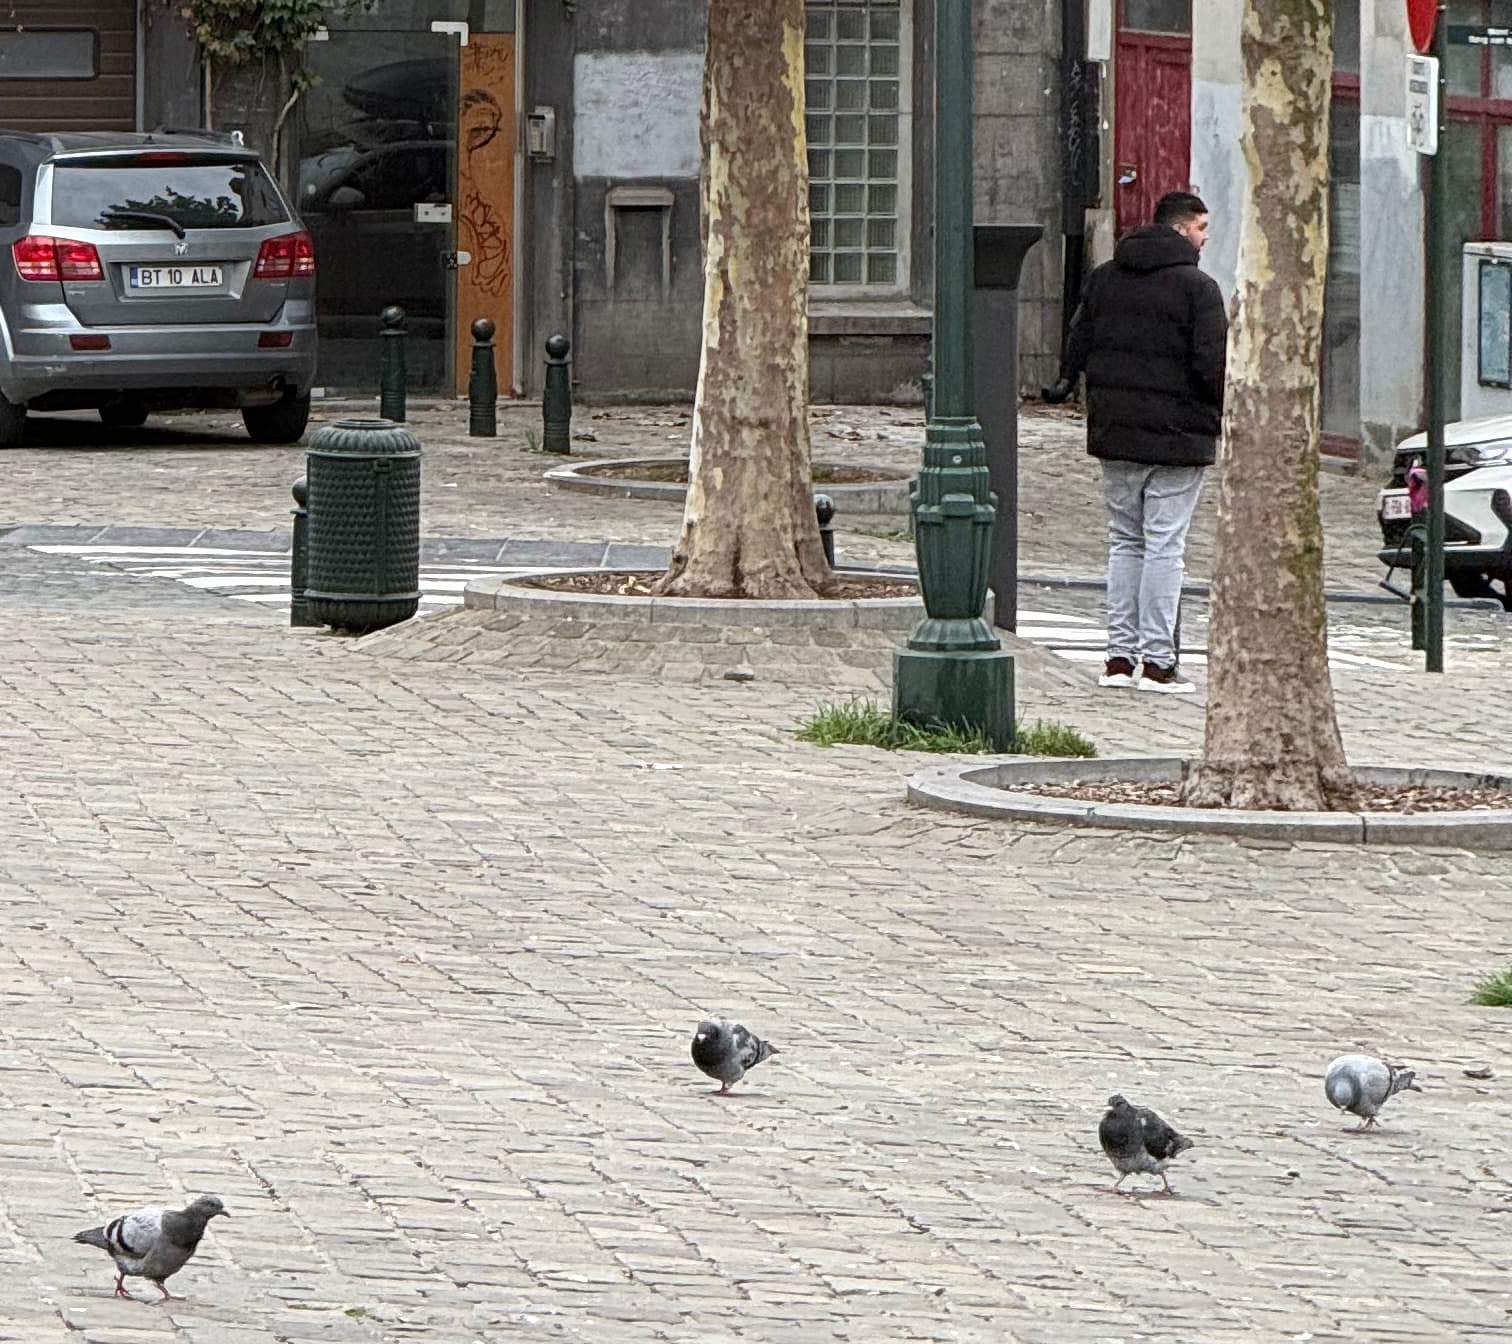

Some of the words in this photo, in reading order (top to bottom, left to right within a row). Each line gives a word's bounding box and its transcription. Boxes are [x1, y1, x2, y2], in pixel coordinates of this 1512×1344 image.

[141, 269, 162, 285] BT
[167, 269, 183, 285] 10
[191, 269, 219, 285] ALA
